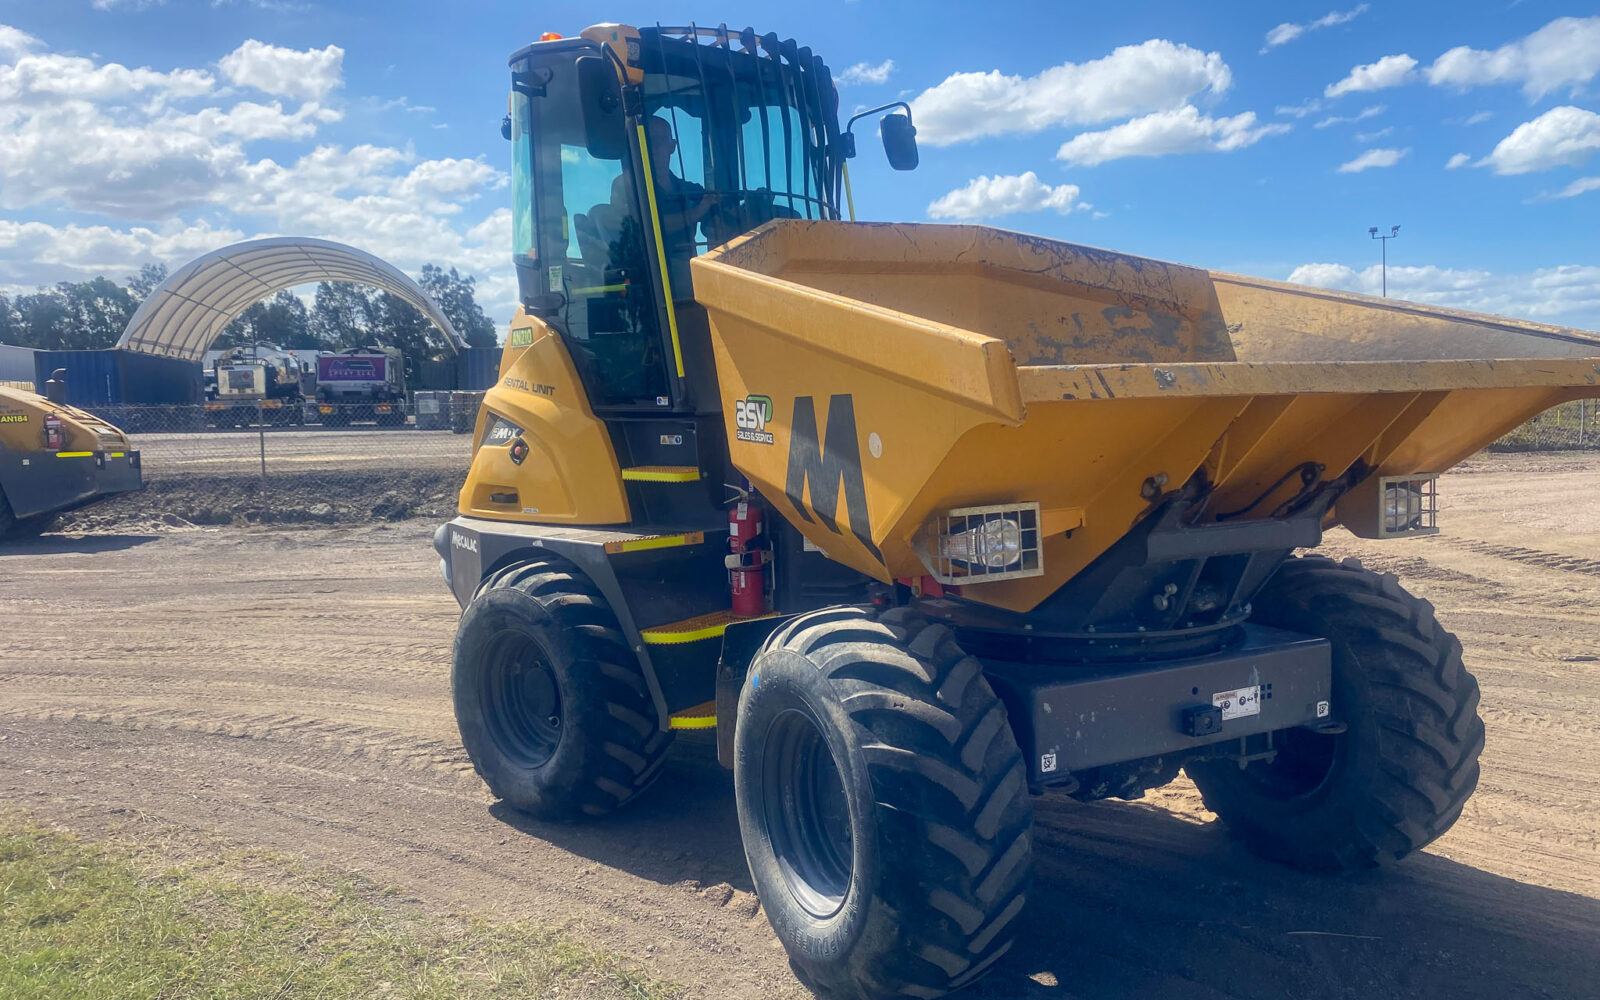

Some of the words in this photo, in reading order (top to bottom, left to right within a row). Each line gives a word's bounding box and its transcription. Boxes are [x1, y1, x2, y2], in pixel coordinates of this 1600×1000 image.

[504, 377, 529, 391] RENTAL
[532, 383, 556, 396] UNIT
[1, 415, 28, 423] AN184
[737, 431, 751, 441] SALES
[755, 433, 773, 443] SERVICE
[785, 394, 887, 567] M
